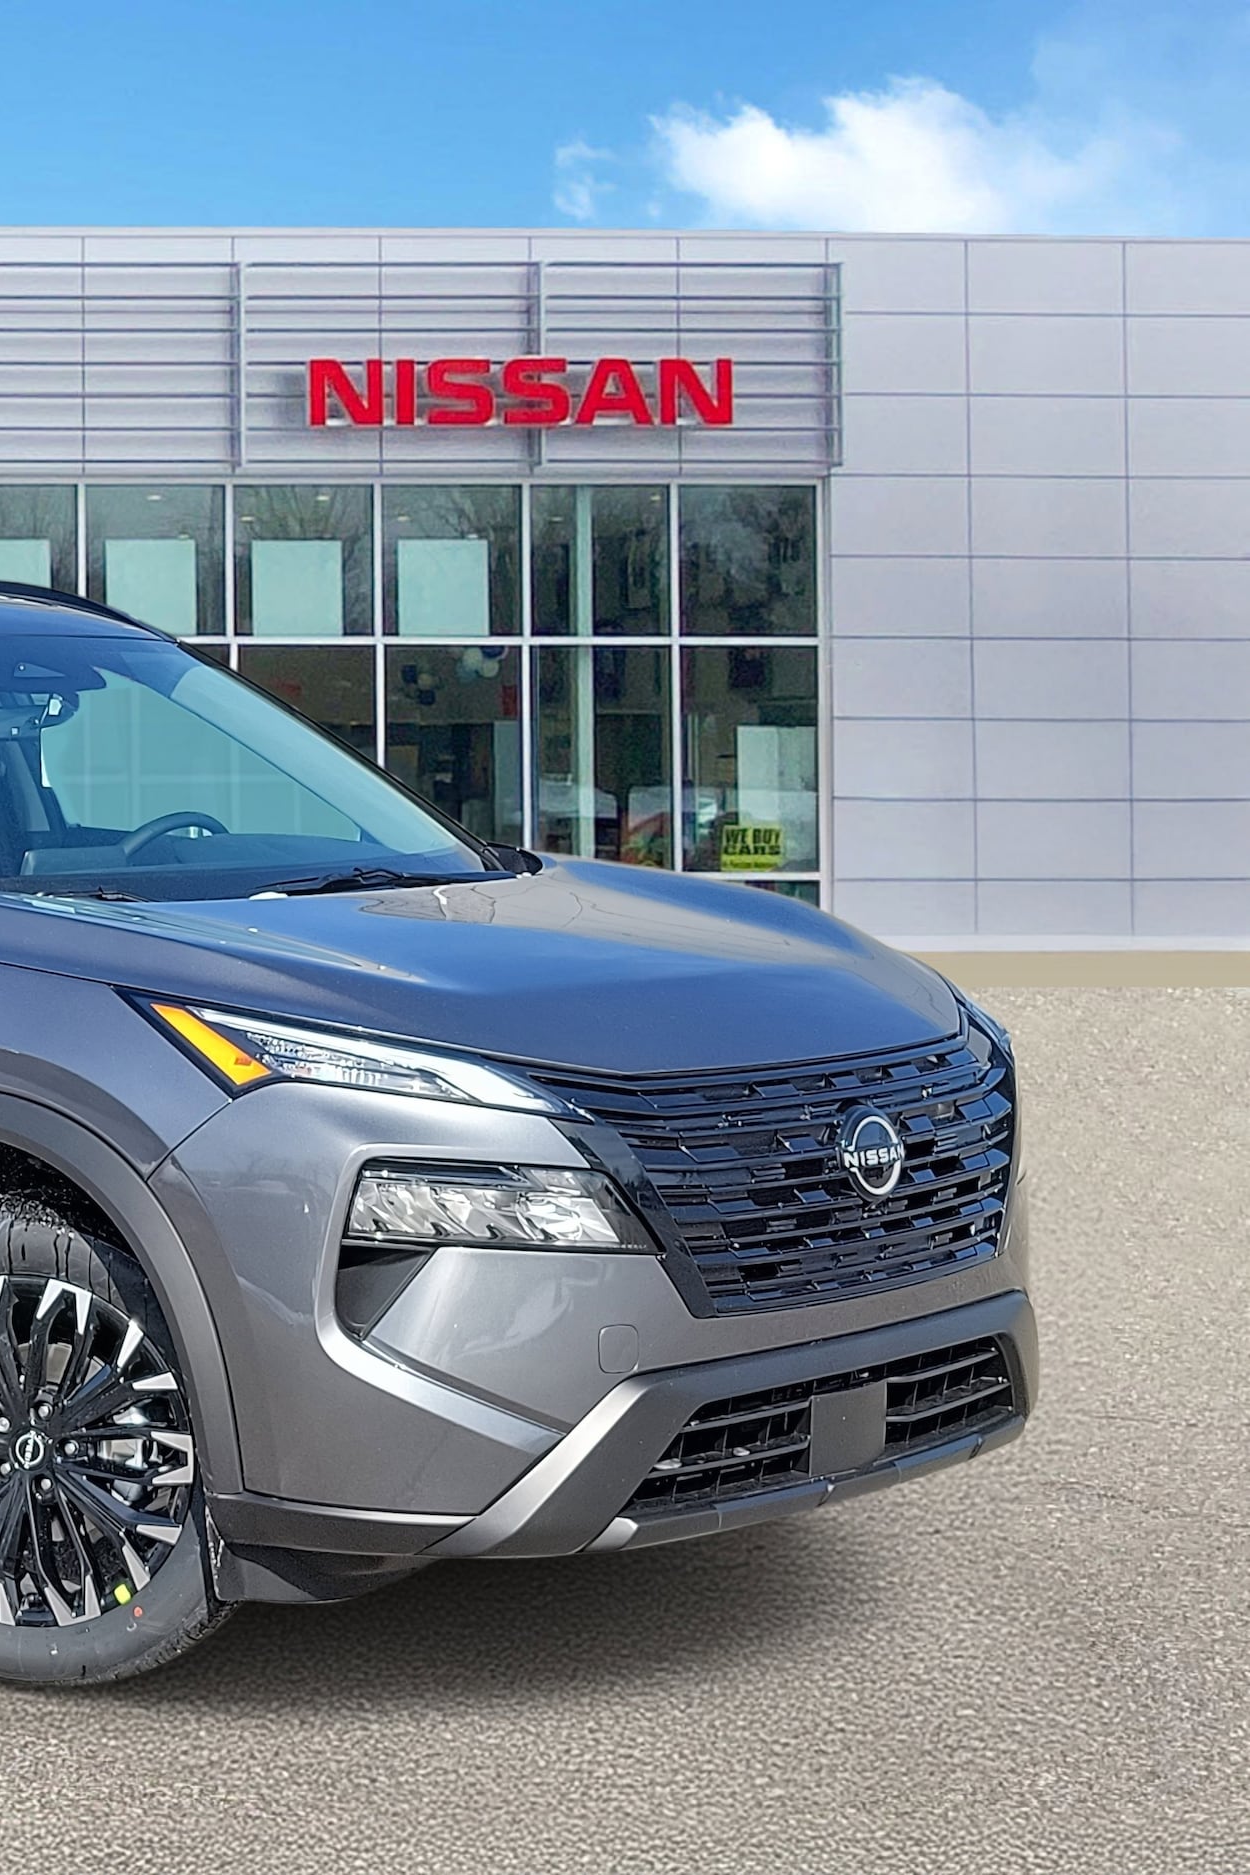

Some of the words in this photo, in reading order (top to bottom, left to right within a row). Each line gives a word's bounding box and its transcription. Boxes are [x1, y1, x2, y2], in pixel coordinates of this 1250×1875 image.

[307, 357, 735, 428] NISSAN
[724, 828, 749, 844] WE
[752, 828, 781, 844] BUY
[723, 844, 781, 856] CARS
[843, 1143, 906, 1169] NISSAN
